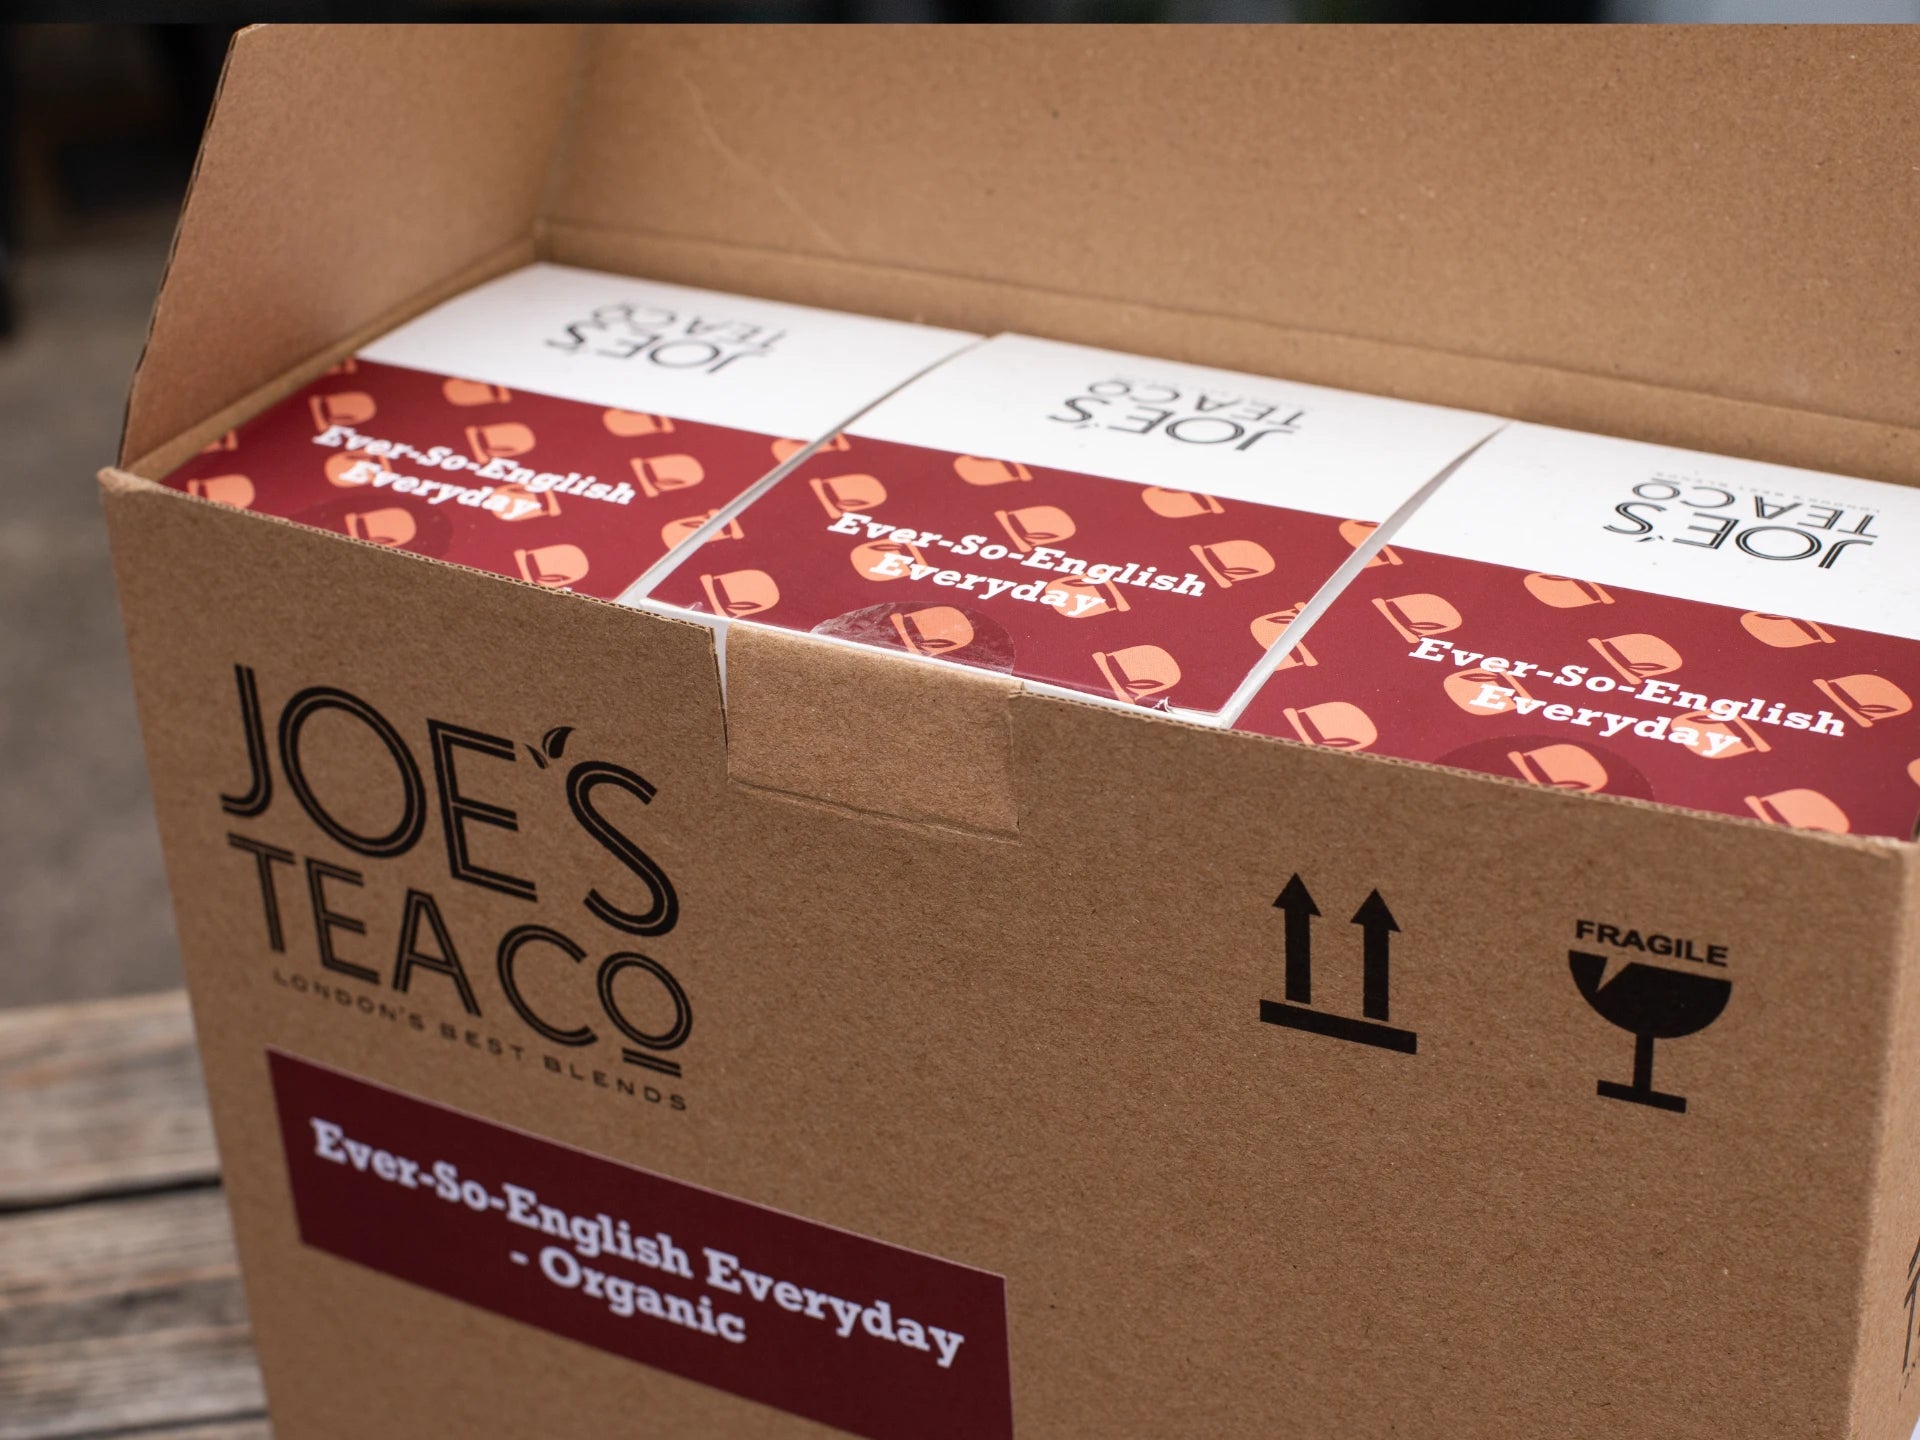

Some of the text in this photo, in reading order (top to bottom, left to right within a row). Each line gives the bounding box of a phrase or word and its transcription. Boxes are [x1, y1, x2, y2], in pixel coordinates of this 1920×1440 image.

[683, 316, 787, 355] TEA
[1046, 396, 1294, 451] JOE'S
[1088, 379, 1180, 403] CO
[1194, 393, 1304, 429] TEA
[312, 424, 636, 505] Ever-So-English
[338, 460, 542, 520] Everyday
[1631, 477, 1736, 509] CO
[1602, 501, 1874, 569] JOE'S
[1754, 495, 1879, 538] TEA
[827, 512, 1207, 598] Ever-So-English
[869, 552, 1106, 619] Everyday
[1408, 637, 1847, 738] Ever-So-English
[1469, 684, 1743, 758] Everyday
[220, 663, 680, 938] JOE'S
[227, 832, 694, 1079] TEA CO
[1575, 919, 1729, 968] FRAGILE
[273, 967, 688, 1113] LONDON'S BEST BLENDS
[310, 1116, 966, 1369] Ever-So-English Everyday
[540, 1246, 748, 1343] Organic
